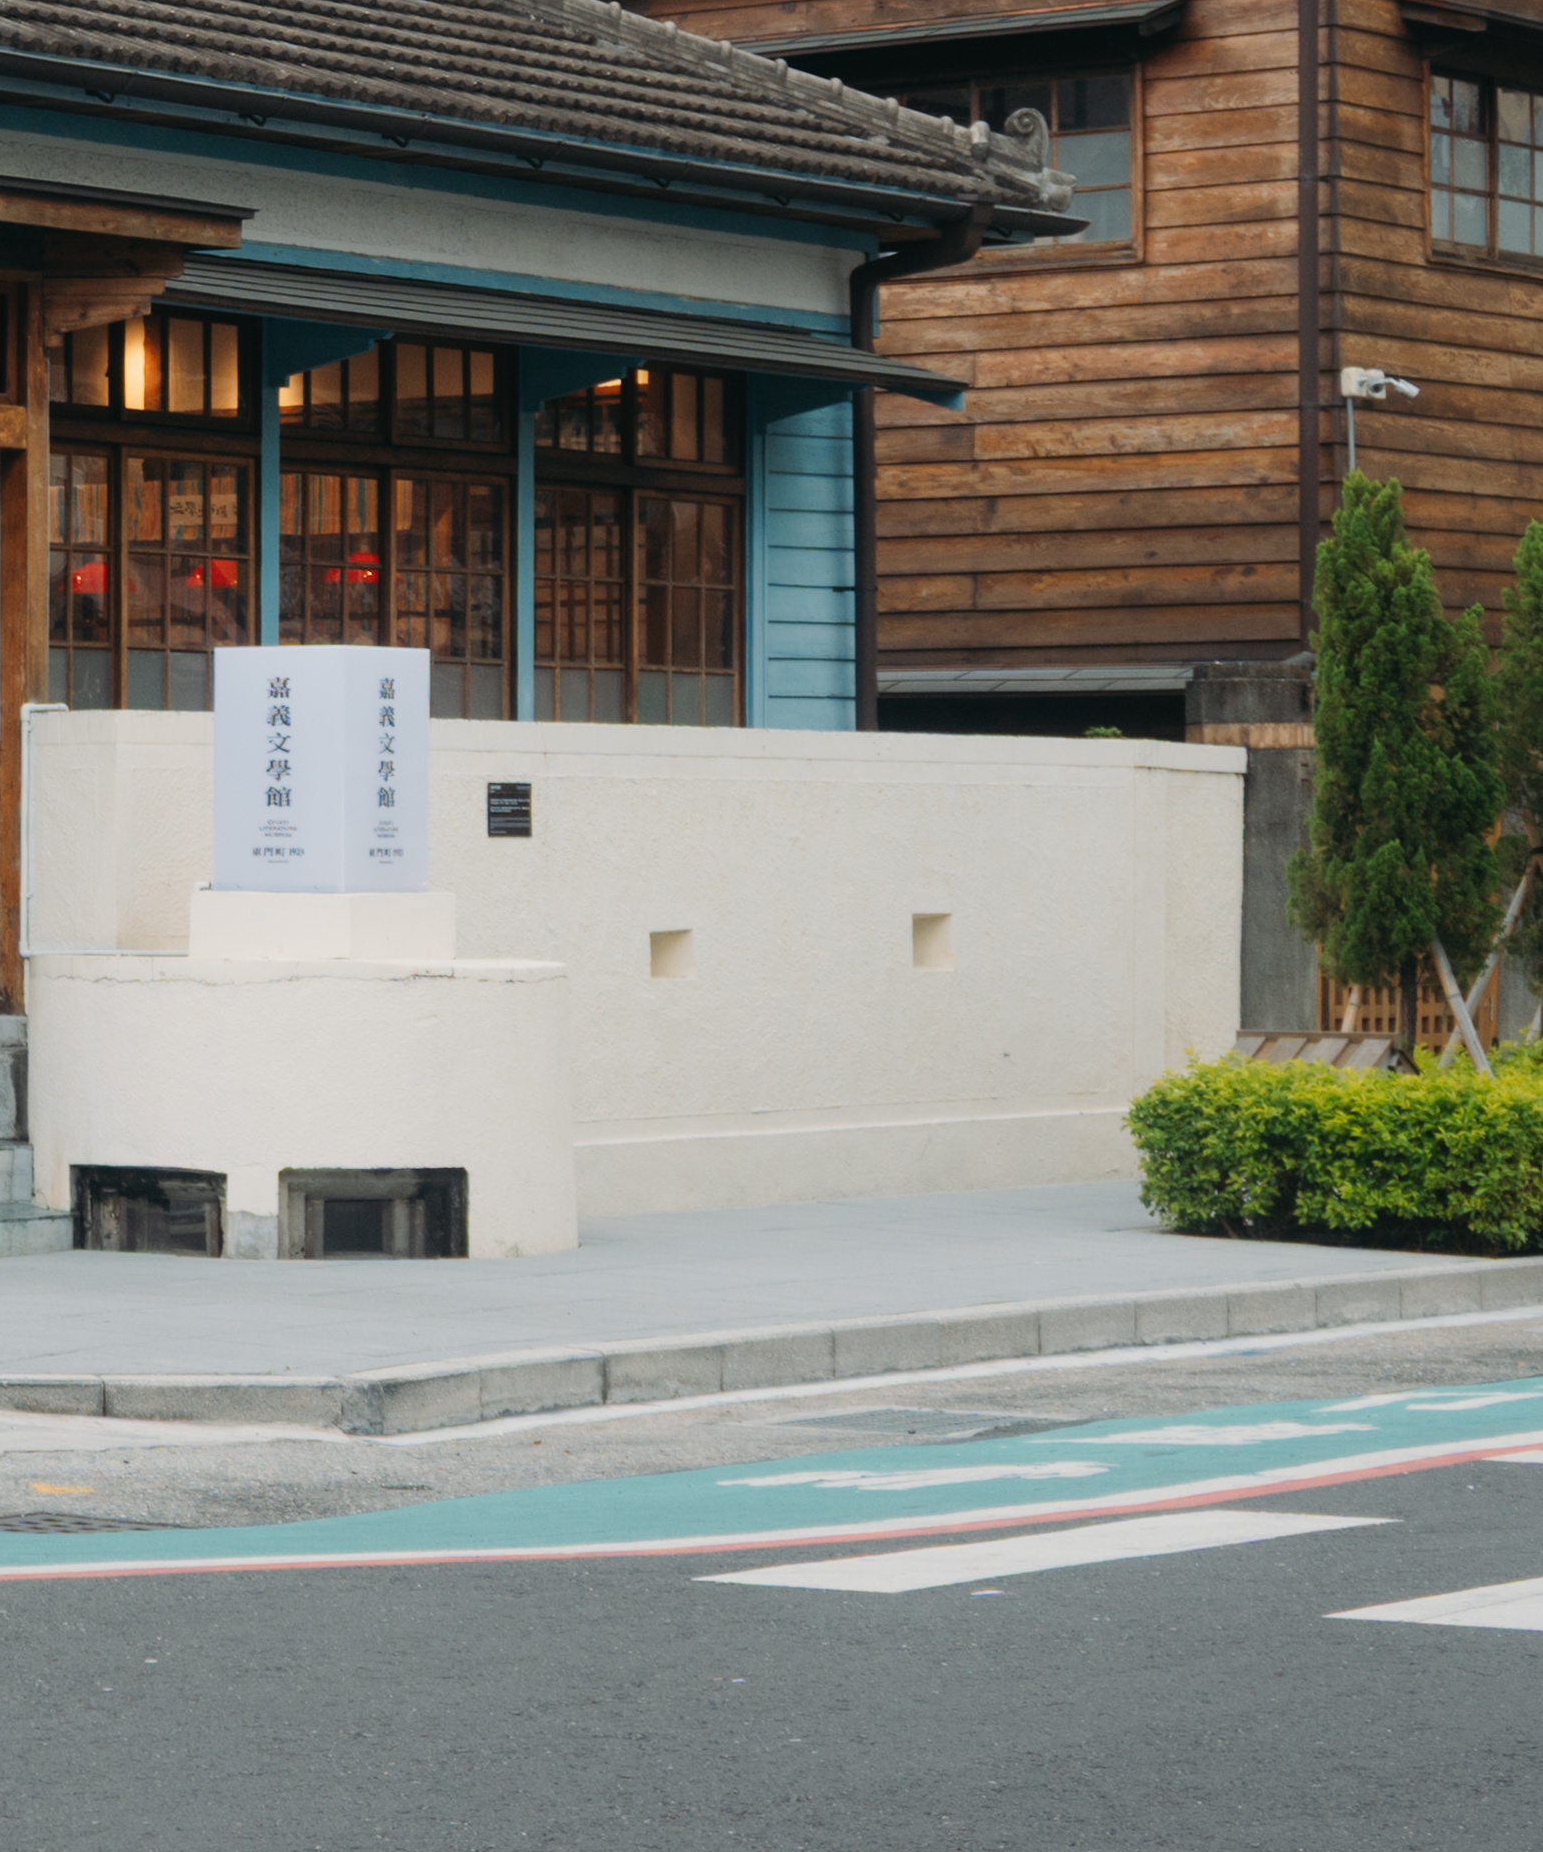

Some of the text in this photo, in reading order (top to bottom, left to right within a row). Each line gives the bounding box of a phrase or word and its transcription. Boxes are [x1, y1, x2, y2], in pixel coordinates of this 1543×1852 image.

[265, 677, 291, 807] 嘉義文學館
[378, 677, 395, 808] 嘉義文學館
